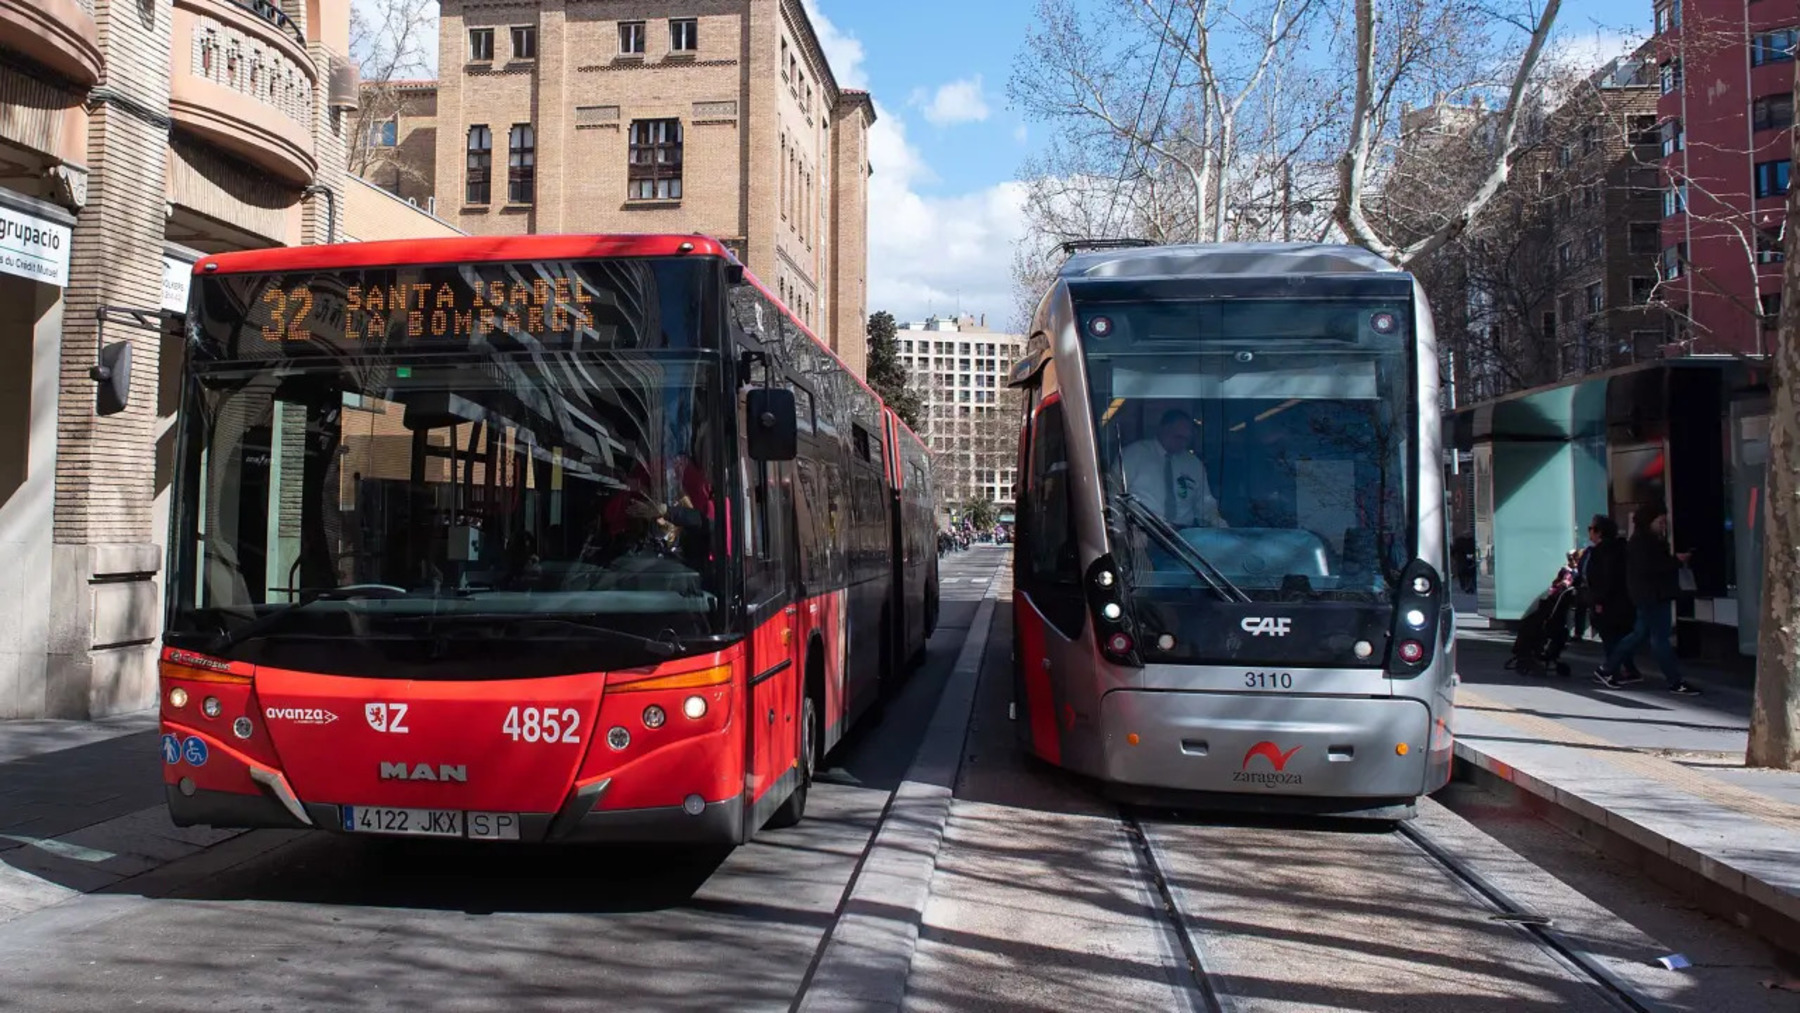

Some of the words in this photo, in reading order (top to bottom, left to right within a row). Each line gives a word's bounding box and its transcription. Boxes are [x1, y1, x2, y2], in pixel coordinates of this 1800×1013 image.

[5, 256, 14, 267] du
[346, 282, 454, 311] SANTA
[473, 277, 592, 307] ISABEL
[262, 286, 313, 340] 32
[345, 312, 385, 338] LA
[408, 305, 594, 337] BOMBARDA
[1241, 617, 1292, 636] CAF
[1244, 671, 1292, 689] 3110
[266, 707, 324, 720] avanza
[388, 703, 409, 733] Z
[502, 706, 581, 744] 4852
[380, 761, 468, 782] MAN
[1232, 770, 1303, 788] zaragoza
[361, 809, 409, 831] 4122
[421, 811, 457, 834] JKX
